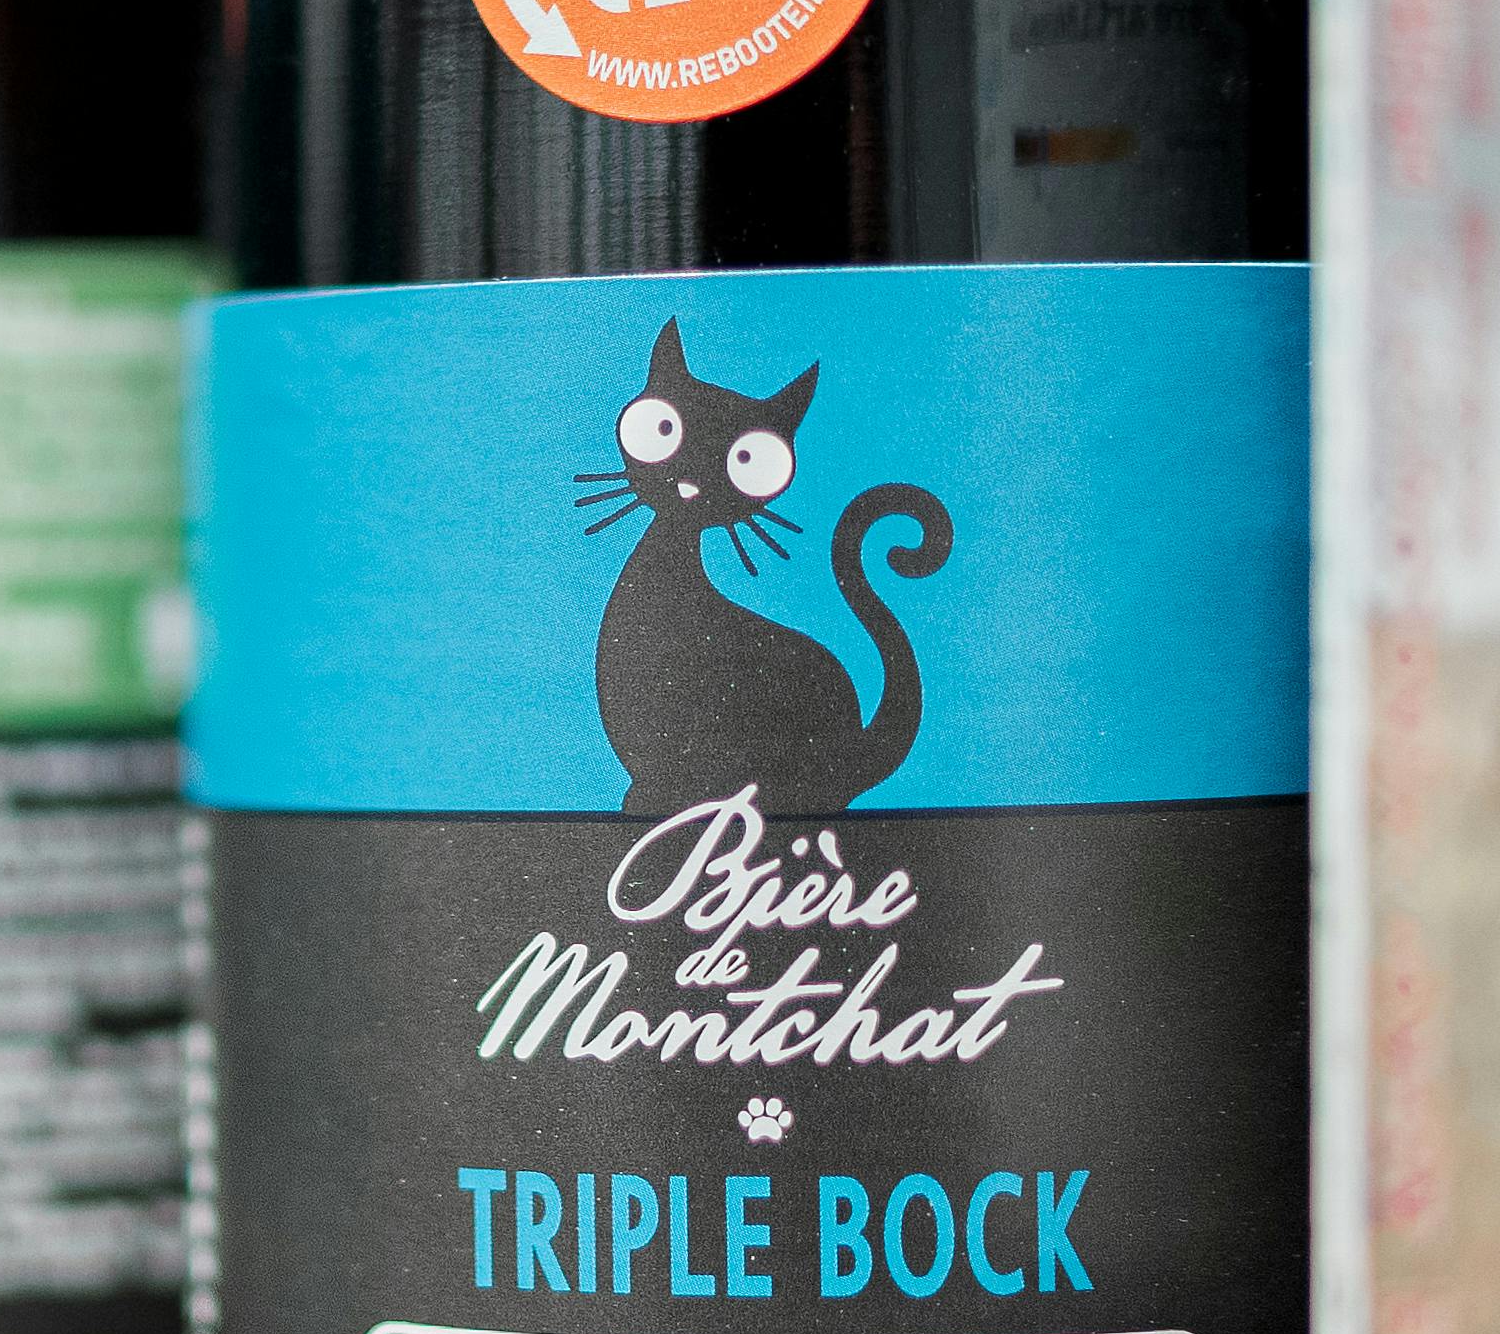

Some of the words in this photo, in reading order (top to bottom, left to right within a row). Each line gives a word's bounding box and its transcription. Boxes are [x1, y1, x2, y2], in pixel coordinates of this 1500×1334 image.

[606, 782, 917, 930] Bière
[476, 931, 1065, 1065] Montchat
[675, 939, 751, 987] de
[457, 1167, 775, 1299] TRIPLE
[818, 1169, 1095, 1299] BOCK
